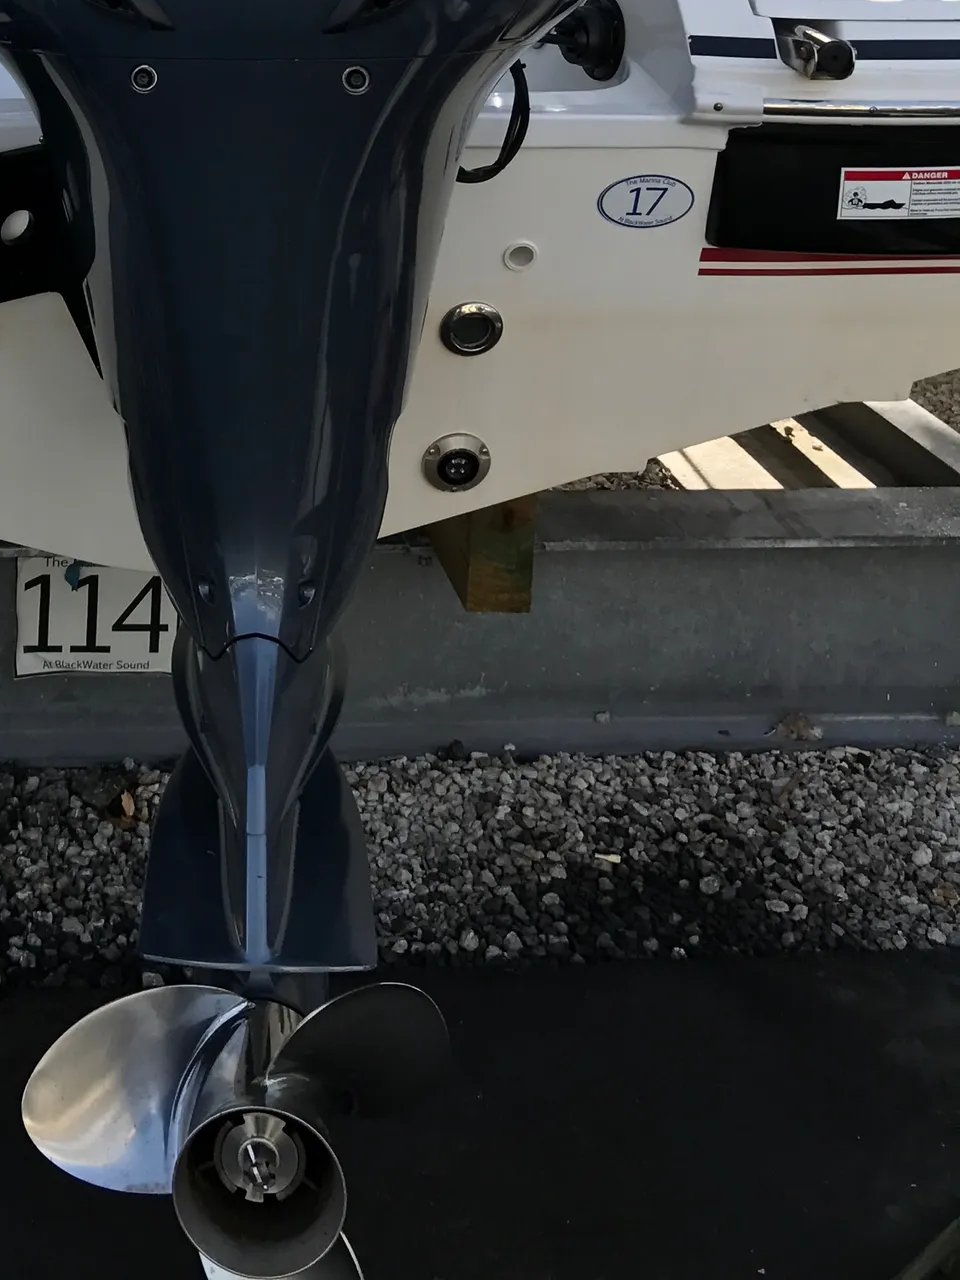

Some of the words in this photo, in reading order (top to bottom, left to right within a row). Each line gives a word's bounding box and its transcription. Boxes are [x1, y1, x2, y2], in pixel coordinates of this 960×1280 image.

[911, 171, 949, 180] DANGER
[625, 187, 668, 216] 17
[45, 556, 69, 568] The
[22, 574, 169, 654] 114
[43, 660, 52, 669] At
[54, 660, 113, 670] BlackWater
[116, 660, 150, 670] Sound
